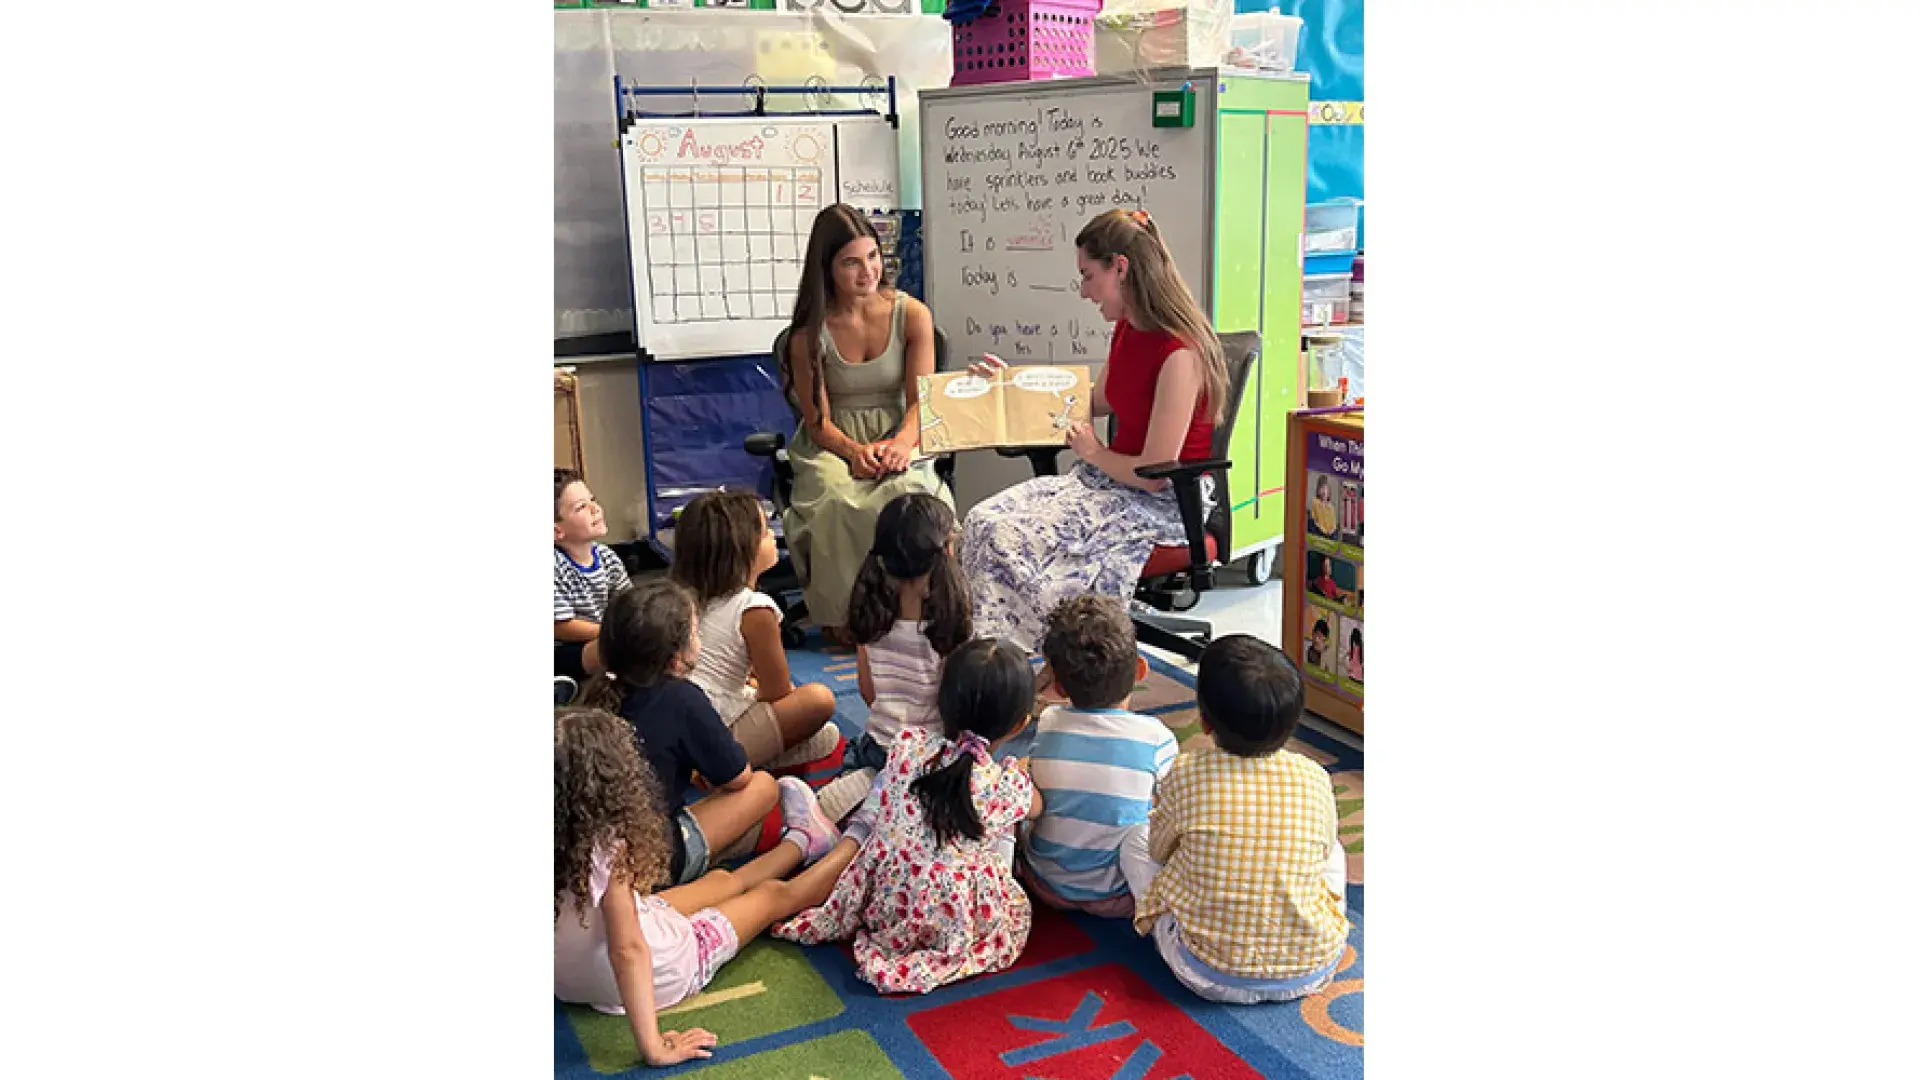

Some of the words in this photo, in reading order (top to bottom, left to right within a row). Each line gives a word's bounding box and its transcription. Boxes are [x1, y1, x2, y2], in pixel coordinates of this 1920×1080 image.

[945, 116, 979, 140] Good
[984, 107, 1042, 146] morning!
[1047, 107, 1084, 139] Today
[1092, 113, 1103, 128] is
[677, 128, 765, 167] August
[943, 142, 1012, 171] Wednesday
[1018, 142, 1060, 168] August
[1089, 136, 1132, 160] 2025
[1134, 138, 1160, 159] We
[946, 169, 971, 192] have
[985, 170, 1048, 193] sprinklers
[1054, 167, 1077, 185] and
[1085, 163, 1116, 184] book
[1124, 162, 1177, 182] buddies
[797, 185, 816, 201] 2
[1025, 191, 1051, 212] have
[1061, 196, 1069, 208] a
[1076, 192, 1105, 216] great
[960, 229, 974, 253] It
[961, 264, 999, 296] Today
[1006, 266, 1017, 288] is
[966, 316, 982, 336] Do
[989, 324, 1008, 345] you
[1016, 319, 1042, 336] have
[1051, 324, 1059, 337] a
[1015, 341, 1032, 355] Yes
[1071, 340, 1088, 355] No
[1318, 433, 1348, 452] When
[1332, 456, 1349, 473] Go
